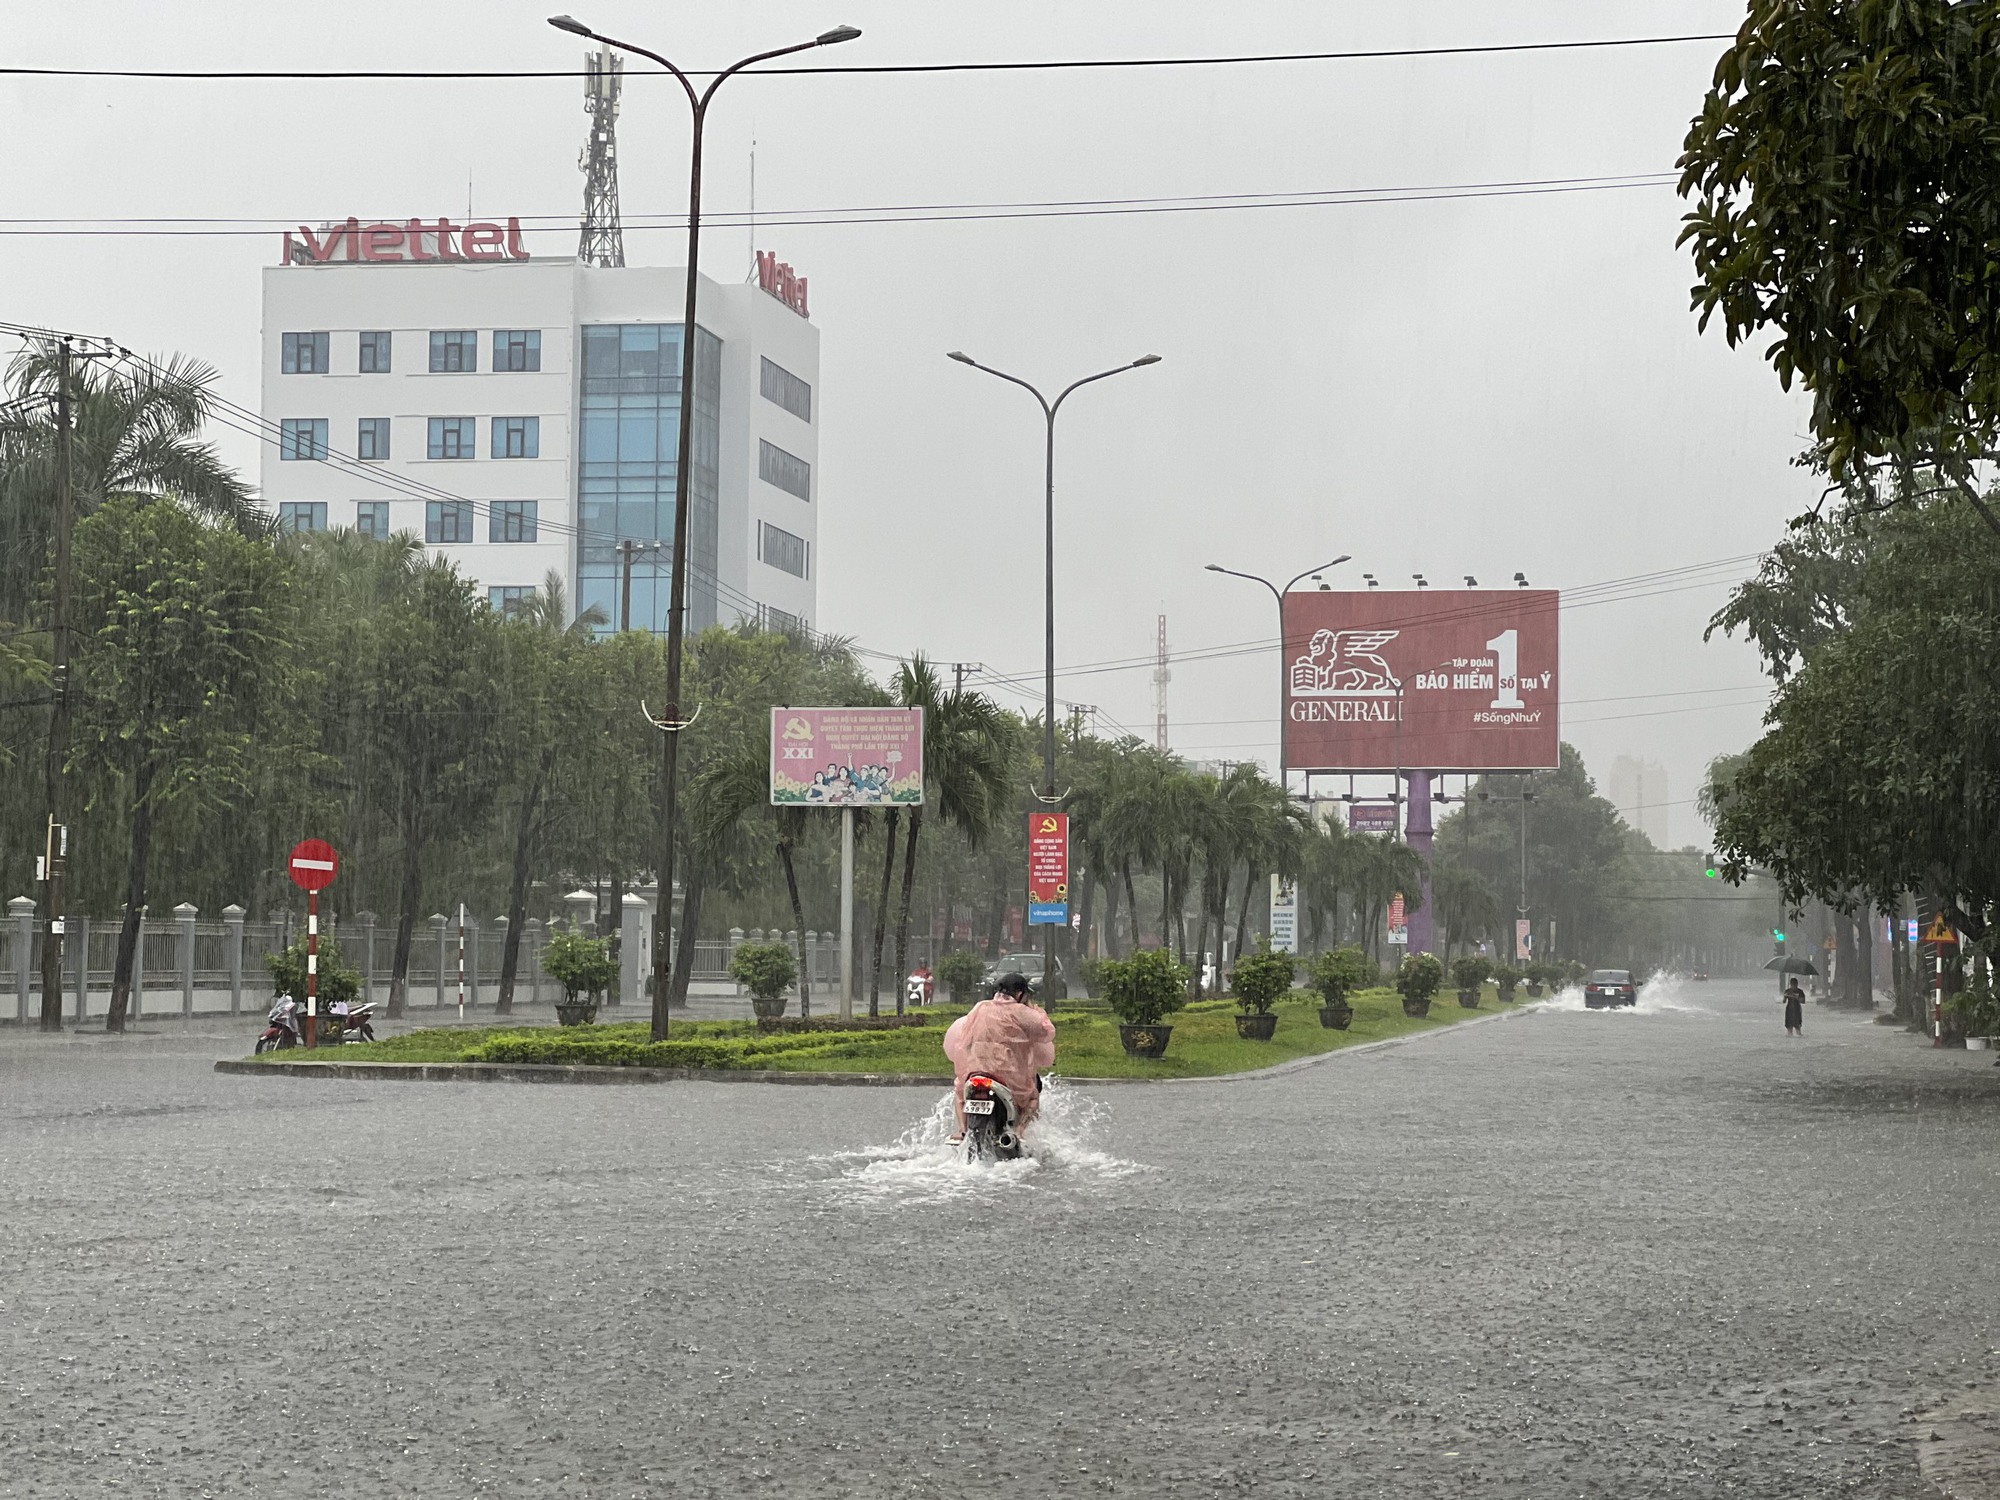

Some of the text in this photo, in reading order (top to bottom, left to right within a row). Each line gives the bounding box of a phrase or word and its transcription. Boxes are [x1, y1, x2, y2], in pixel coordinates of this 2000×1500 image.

[298, 216, 530, 261] viettel
[1452, 657, 1494, 669] TẬP ĐOÀN
[1486, 629, 1525, 709] 1
[1416, 668, 1551, 691] BẢO HIỂM SỐ TẠI Ý
[1473, 709, 1541, 724] #SốngNhưÝ
[782, 747, 815, 759] XXI
